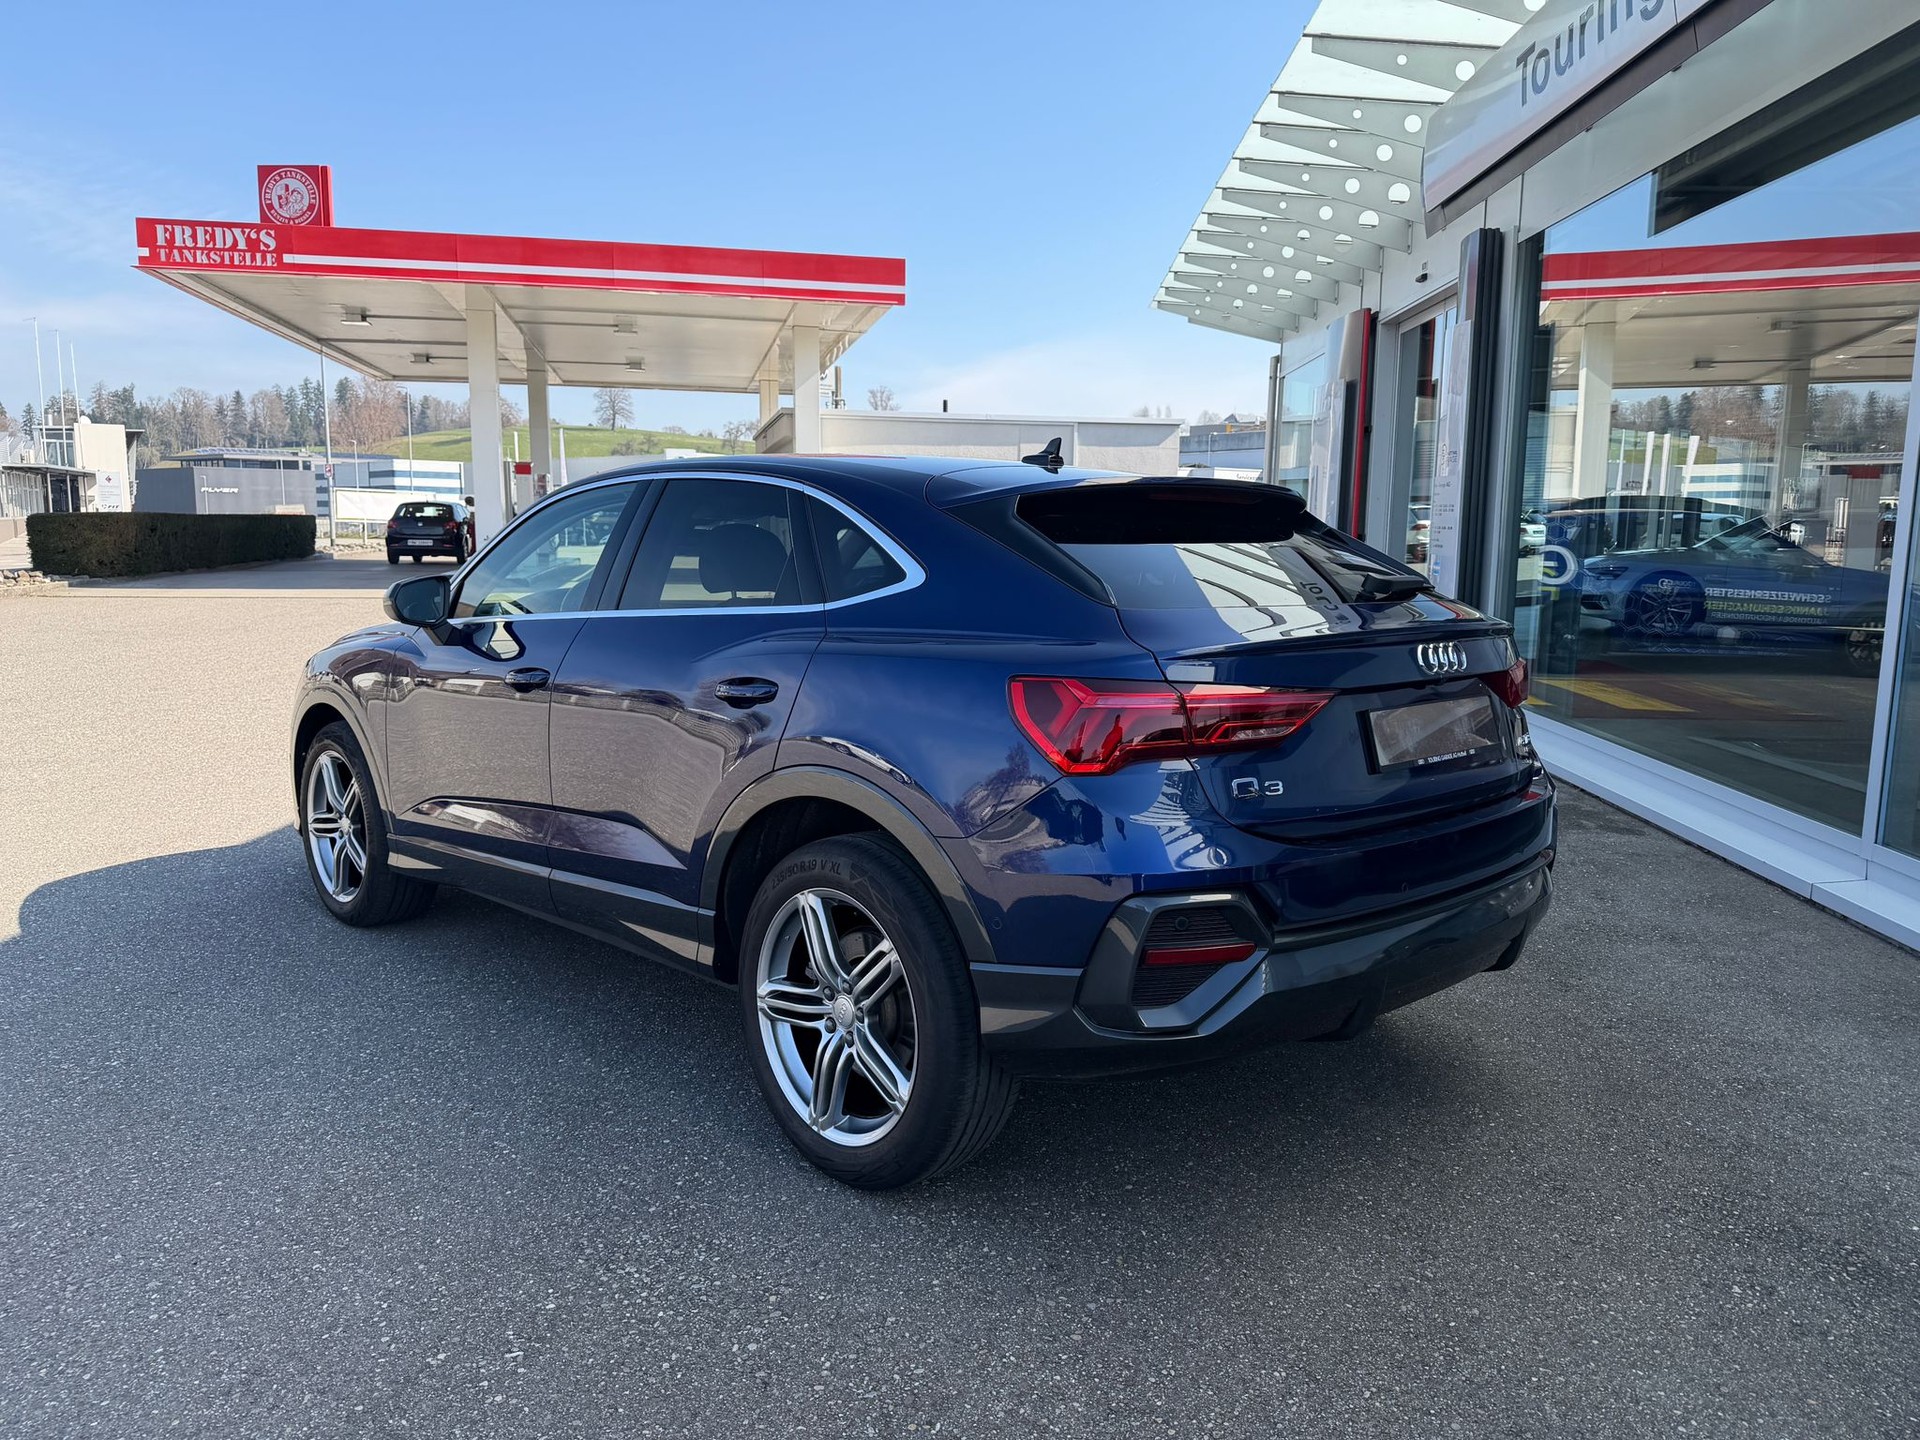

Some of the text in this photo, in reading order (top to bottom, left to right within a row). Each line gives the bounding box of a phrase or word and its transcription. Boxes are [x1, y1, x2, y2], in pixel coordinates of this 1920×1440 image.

[280, 171, 316, 204] TANKSTELLE
[155, 224, 277, 251] FREDY'S
[157, 248, 277, 267] TANKSTELLE
[1231, 777, 1284, 800] Q3
